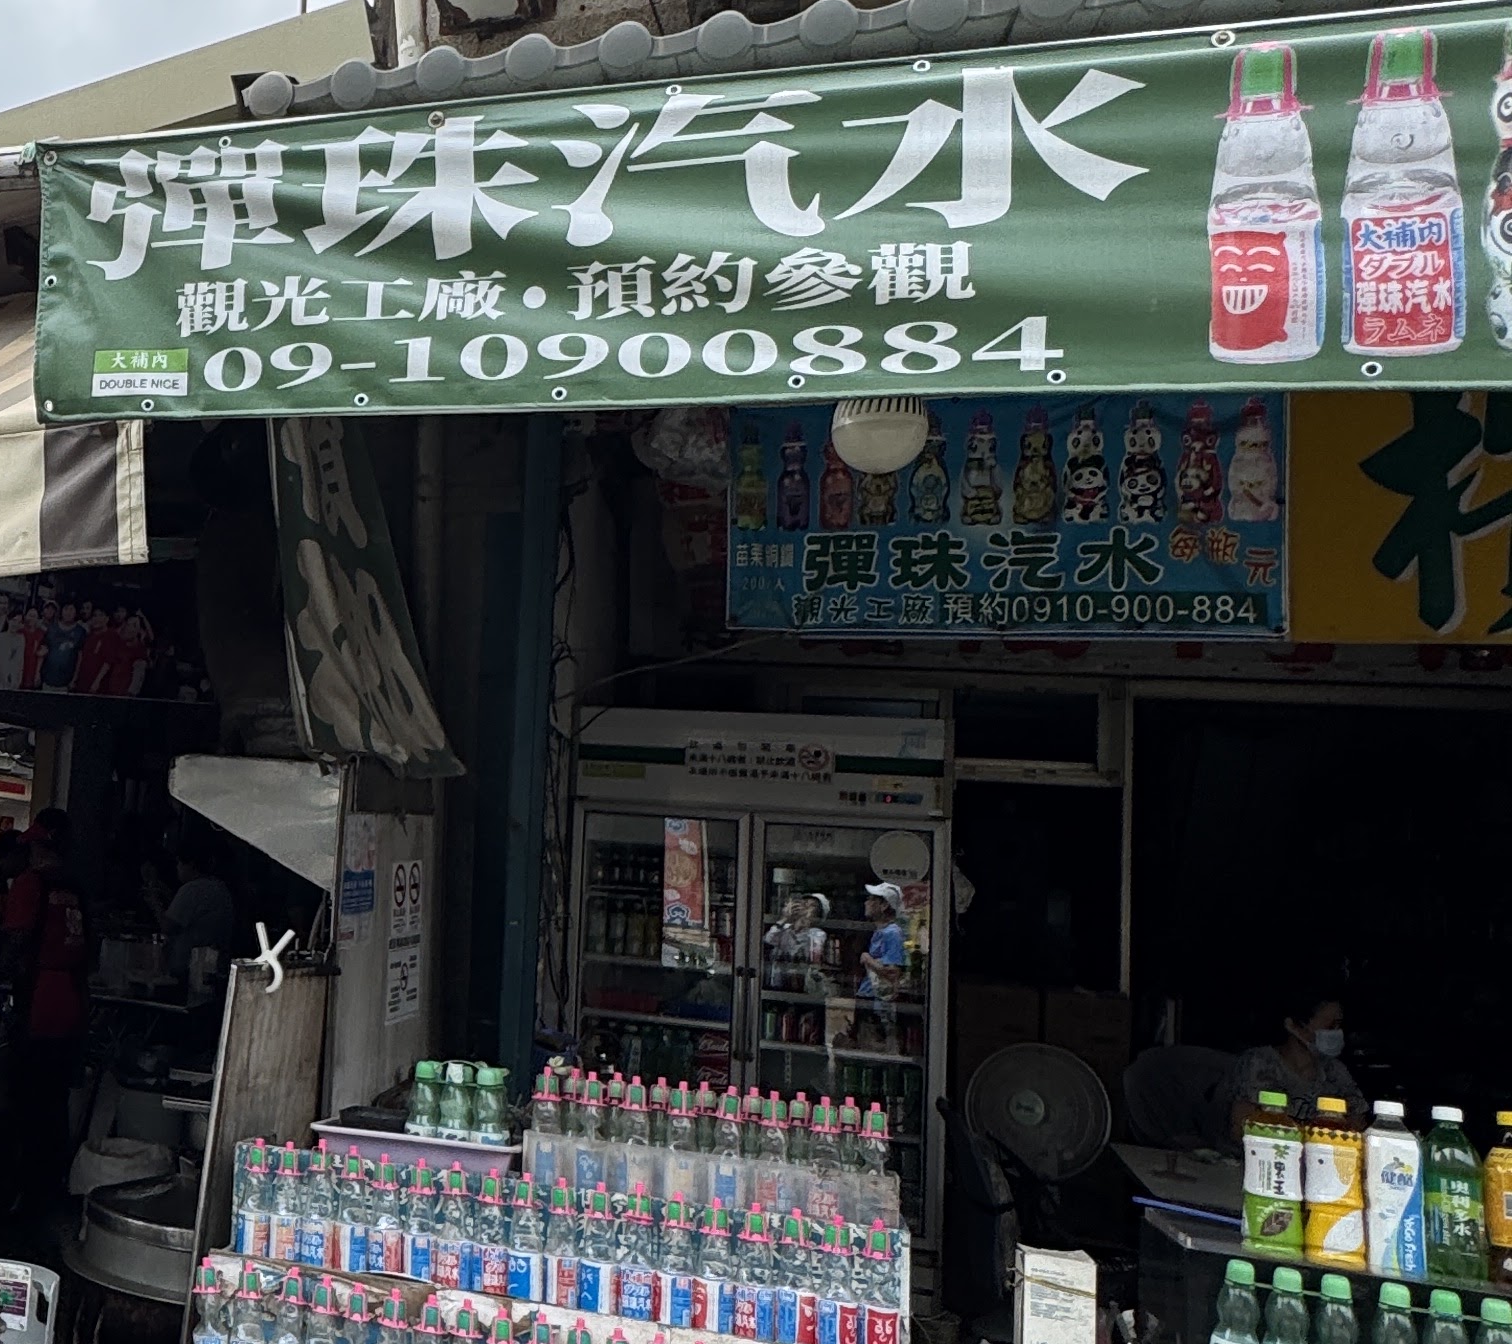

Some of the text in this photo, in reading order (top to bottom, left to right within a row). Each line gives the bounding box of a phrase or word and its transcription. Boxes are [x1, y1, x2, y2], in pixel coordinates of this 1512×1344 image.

[86, 67, 1150, 281] 彈珠汽水
[1356, 219, 1446, 251] 大補內
[1355, 277, 1452, 316] 彈珠汽水
[111, 352, 168, 369] 大補內
[203, 316, 1064, 392] 09-10900884
[100, 378, 180, 390] DOUBLE NICE
[801, 528, 1165, 595] 彈珠汽水
[1243, 547, 1279, 586] 元
